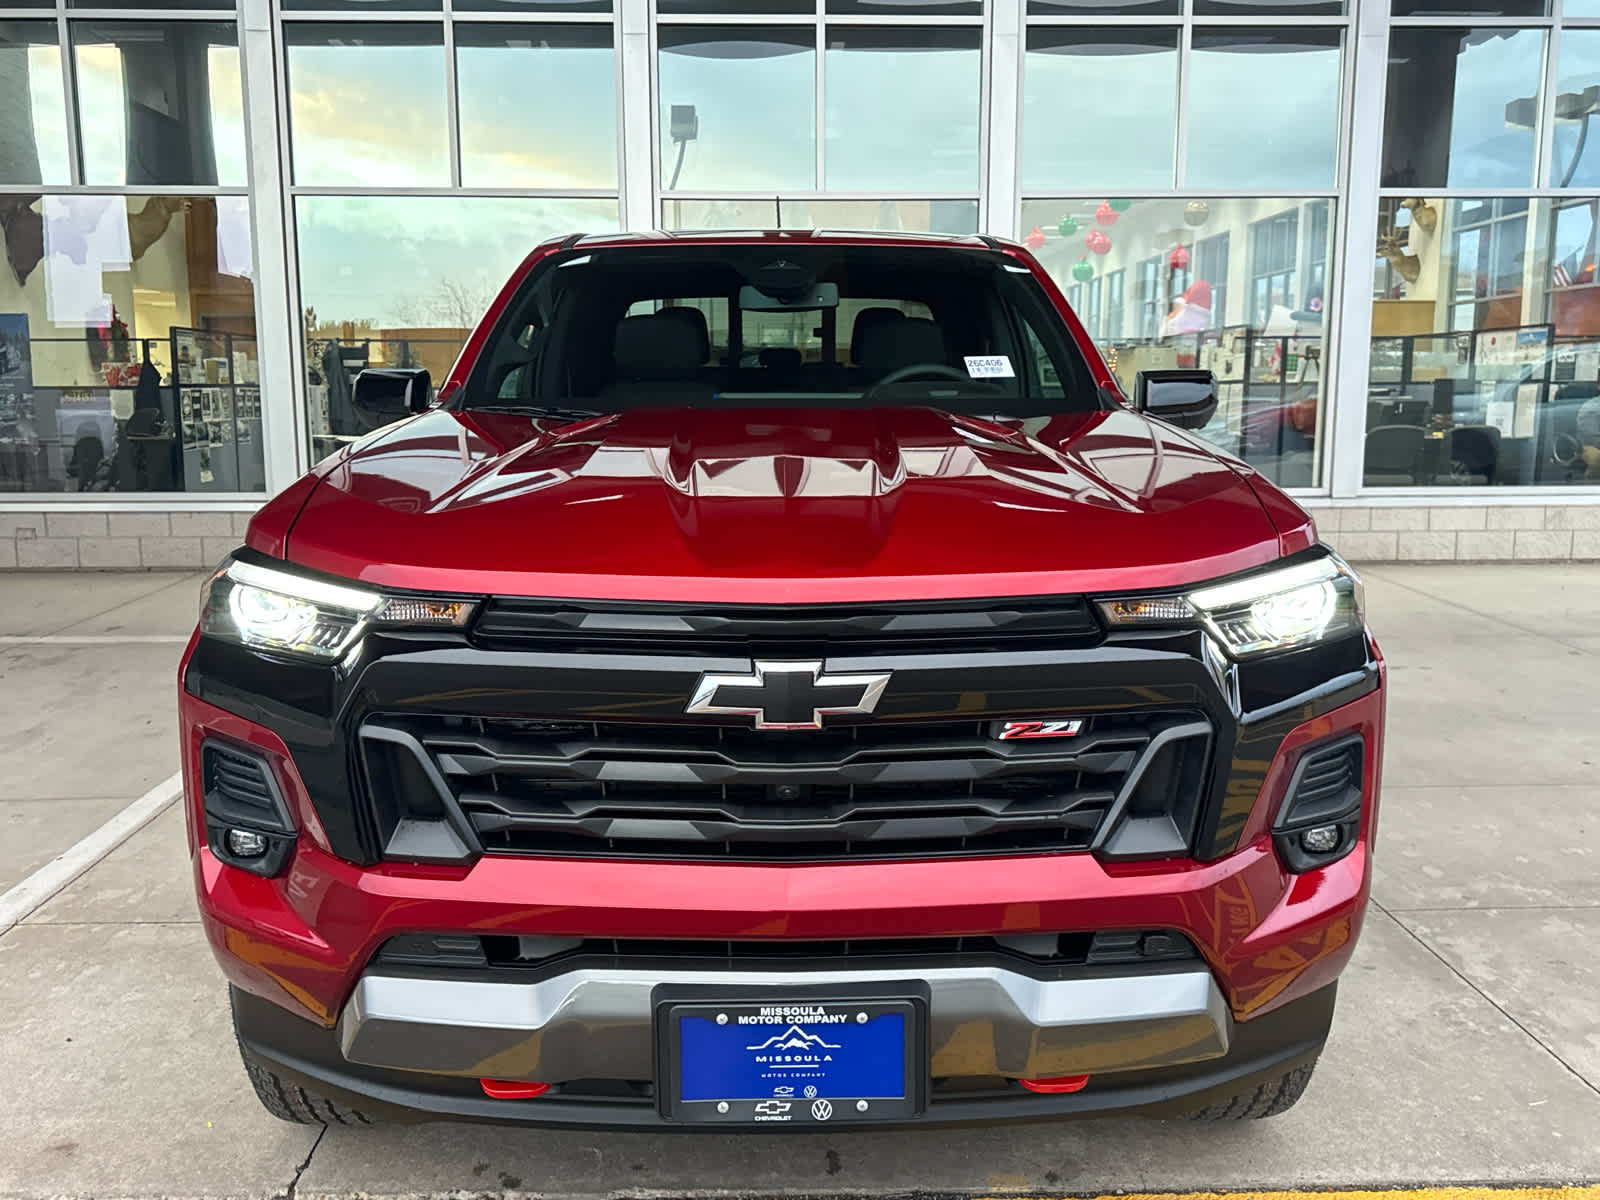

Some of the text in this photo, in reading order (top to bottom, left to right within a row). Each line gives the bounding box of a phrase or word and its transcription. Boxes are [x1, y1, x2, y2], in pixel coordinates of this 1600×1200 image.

[998, 720, 1082, 739] Z71
[760, 1007, 825, 1016] MISSOULA
[738, 1015, 847, 1024] MOTOR COMPANY
